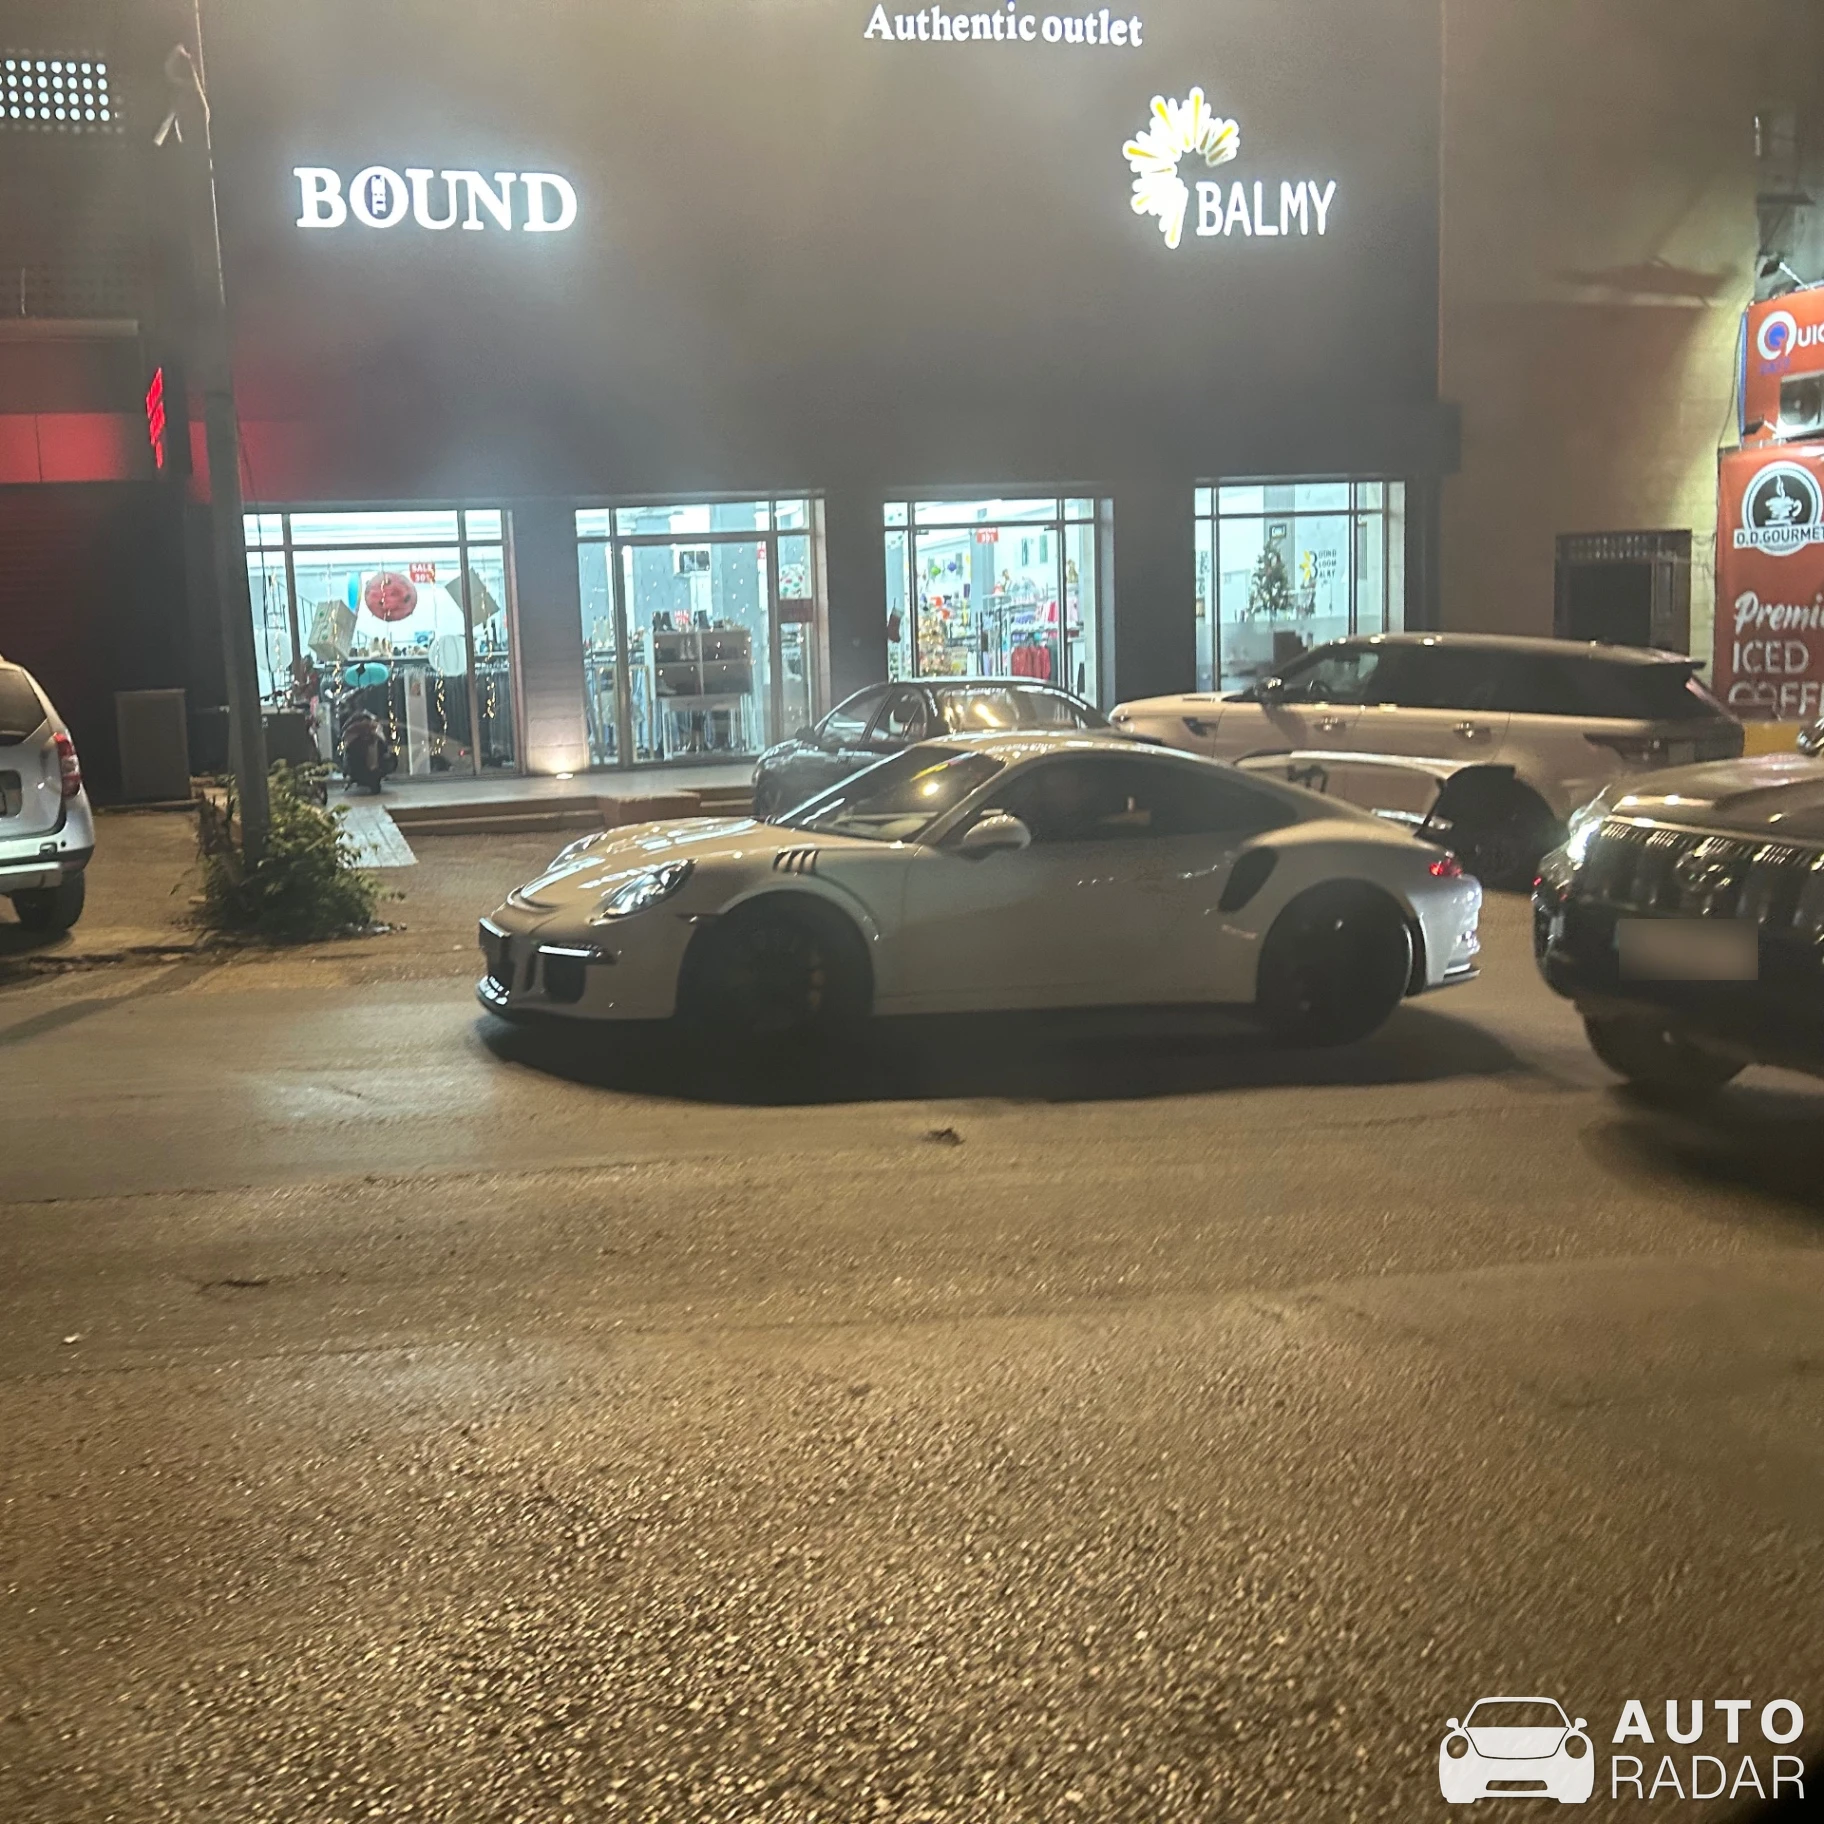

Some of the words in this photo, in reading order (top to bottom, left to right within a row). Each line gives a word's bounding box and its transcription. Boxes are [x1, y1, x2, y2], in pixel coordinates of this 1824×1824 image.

[864, 1, 1037, 41] Authentic
[1042, 9, 1143, 47] outlet
[293, 166, 577, 232] BOUND
[1195, 180, 1336, 236] BALMY
[1733, 591, 1824, 635] Premi
[1733, 641, 1809, 674] ICED
[1728, 682, 1824, 717] COFF
